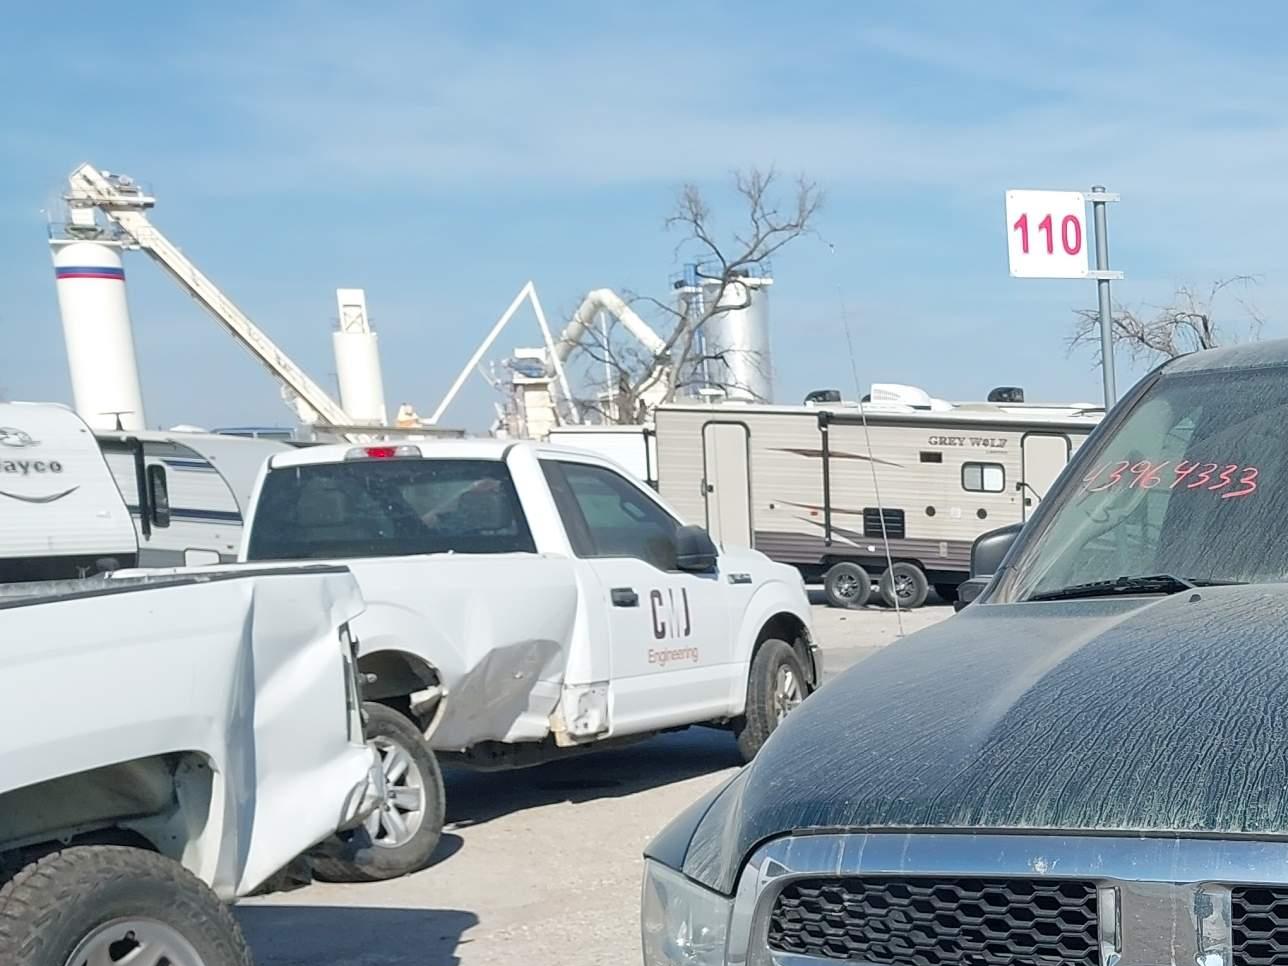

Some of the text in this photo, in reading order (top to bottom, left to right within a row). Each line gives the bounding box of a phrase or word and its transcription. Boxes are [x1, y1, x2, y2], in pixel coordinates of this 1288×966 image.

[1014, 213, 1081, 255] 110
[928, 435, 1008, 448] GREY WOLF
[0, 460, 63, 476] ayco
[1079, 460, 1258, 498] 43964333
[648, 647, 699, 666] Engineering
